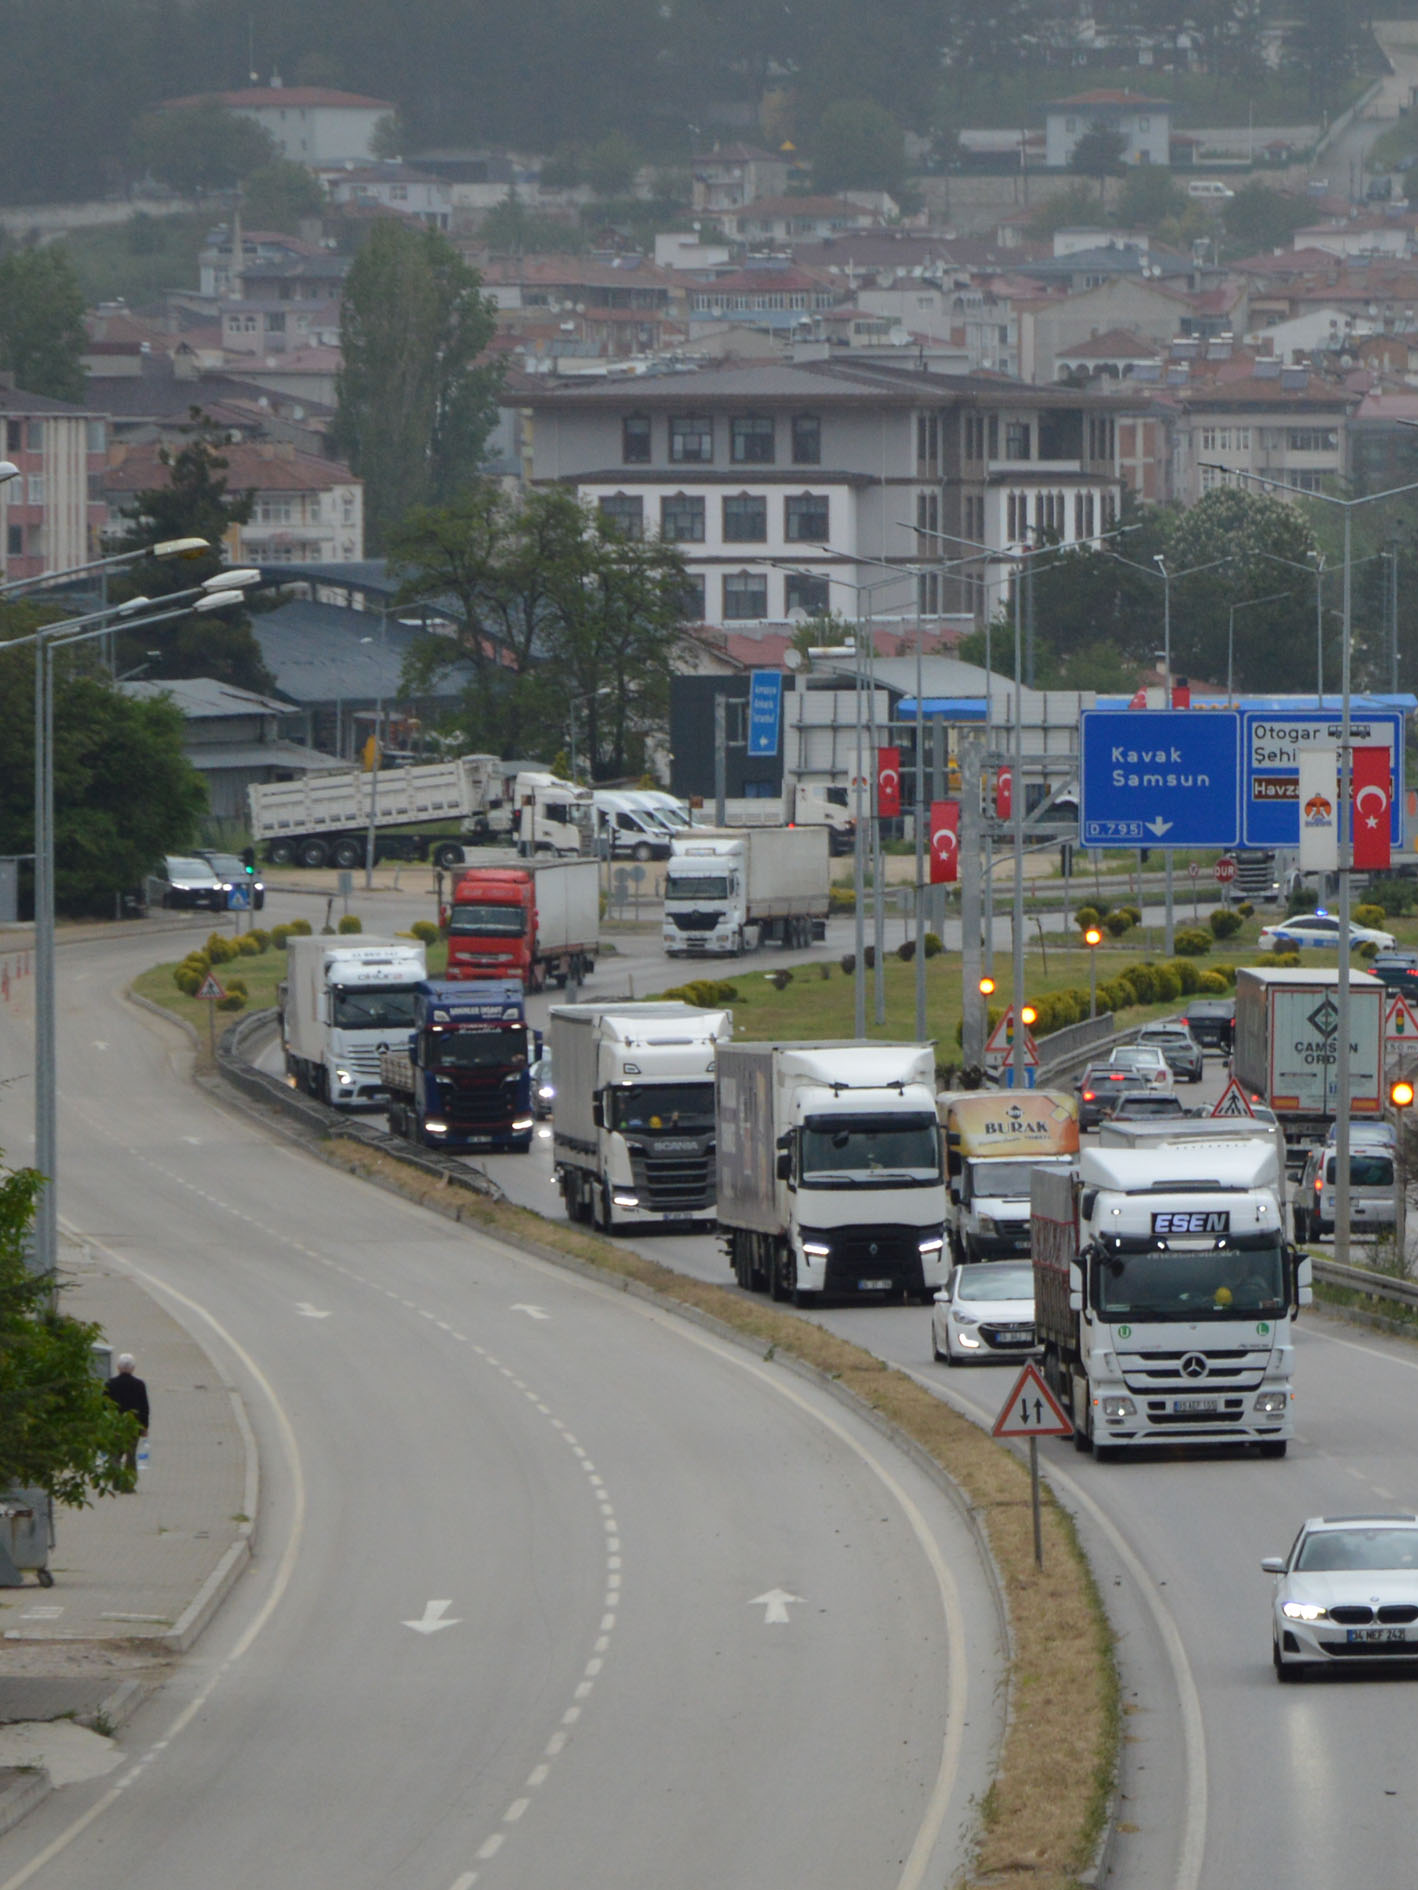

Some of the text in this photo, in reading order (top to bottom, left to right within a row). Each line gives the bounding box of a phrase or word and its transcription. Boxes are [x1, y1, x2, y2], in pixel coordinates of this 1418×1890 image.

[1254, 725, 1321, 744] Otogar
[1112, 746, 1182, 763] Kavak
[1254, 746, 1297, 765] Şehi
[1113, 769, 1210, 787] Samsun
[1254, 781, 1300, 796] Havz
[1090, 823, 1138, 835] D.795
[1215, 865, 1234, 877] DUR
[1294, 1042, 1358, 1054] CAMSN
[1304, 1054, 1337, 1065] ORD
[985, 1120, 1049, 1136] BURAK
[1154, 1213, 1227, 1233] ESEN
